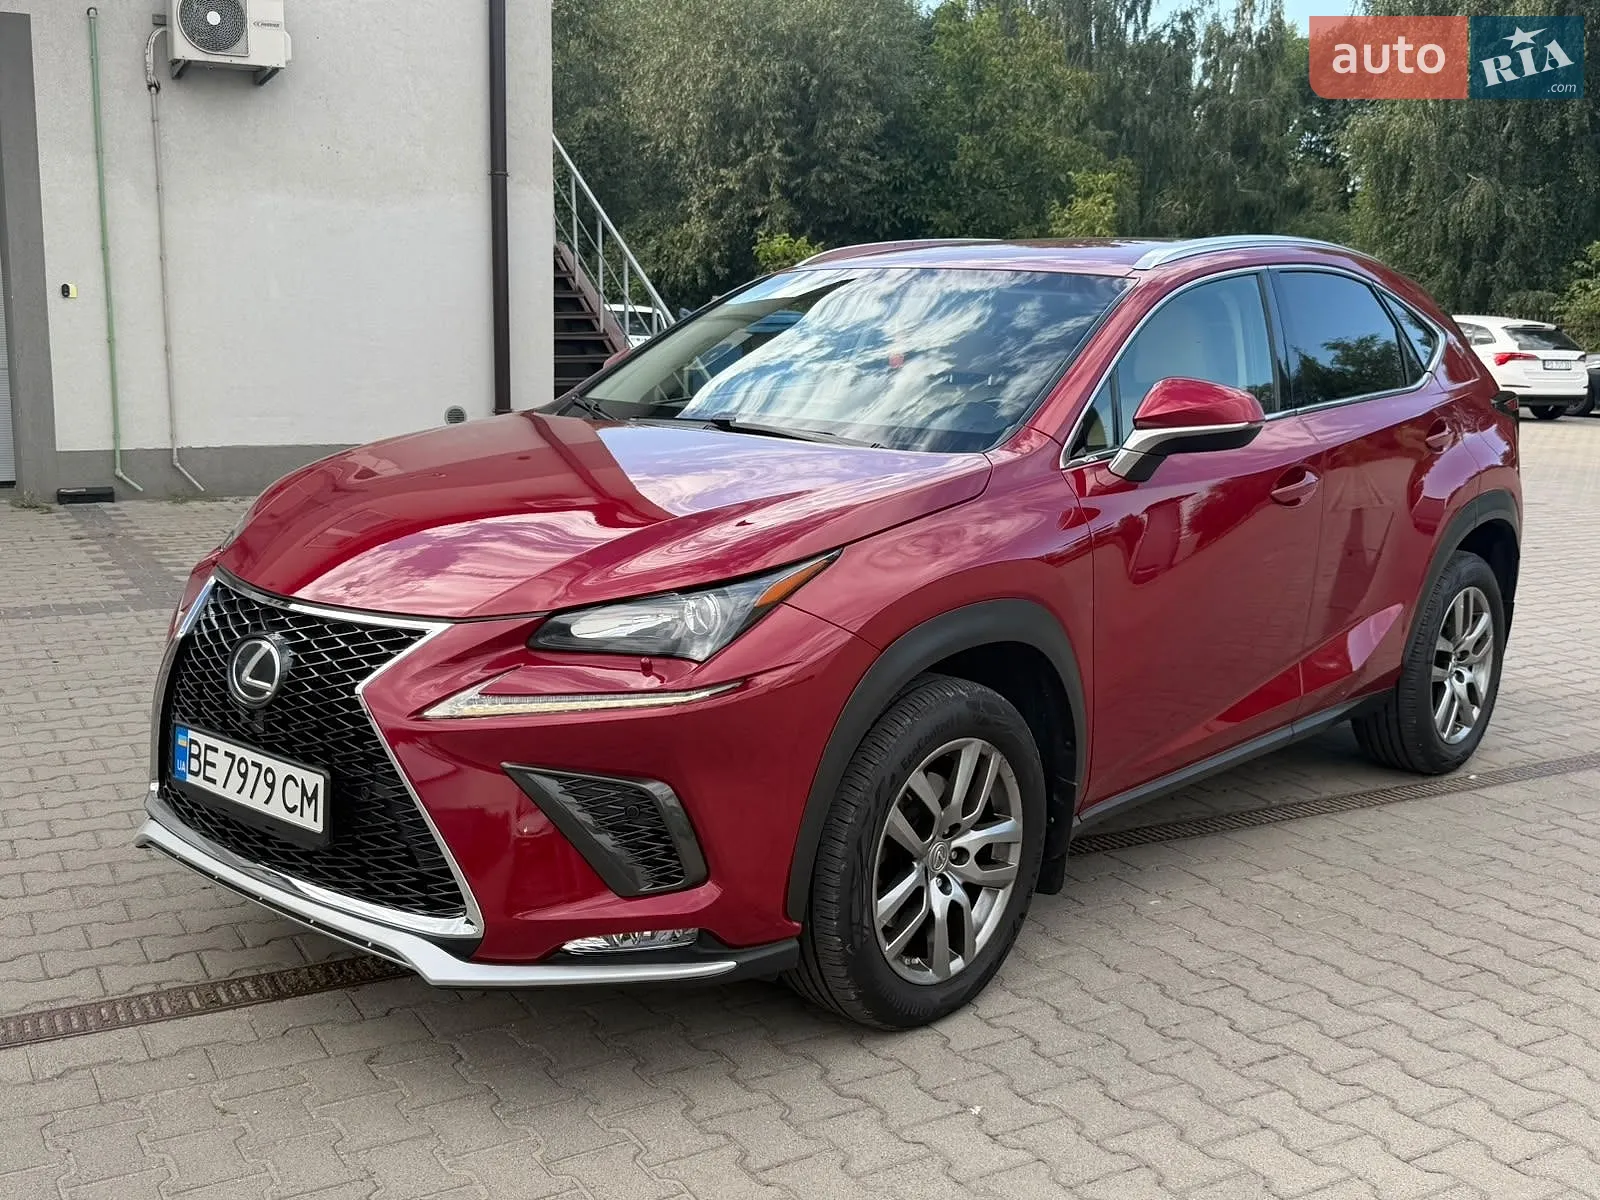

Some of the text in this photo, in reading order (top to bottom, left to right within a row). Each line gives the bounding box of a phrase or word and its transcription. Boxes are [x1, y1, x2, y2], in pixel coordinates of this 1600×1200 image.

[177, 759, 186, 772] UA
[187, 737, 319, 823] BE 7979 CM
